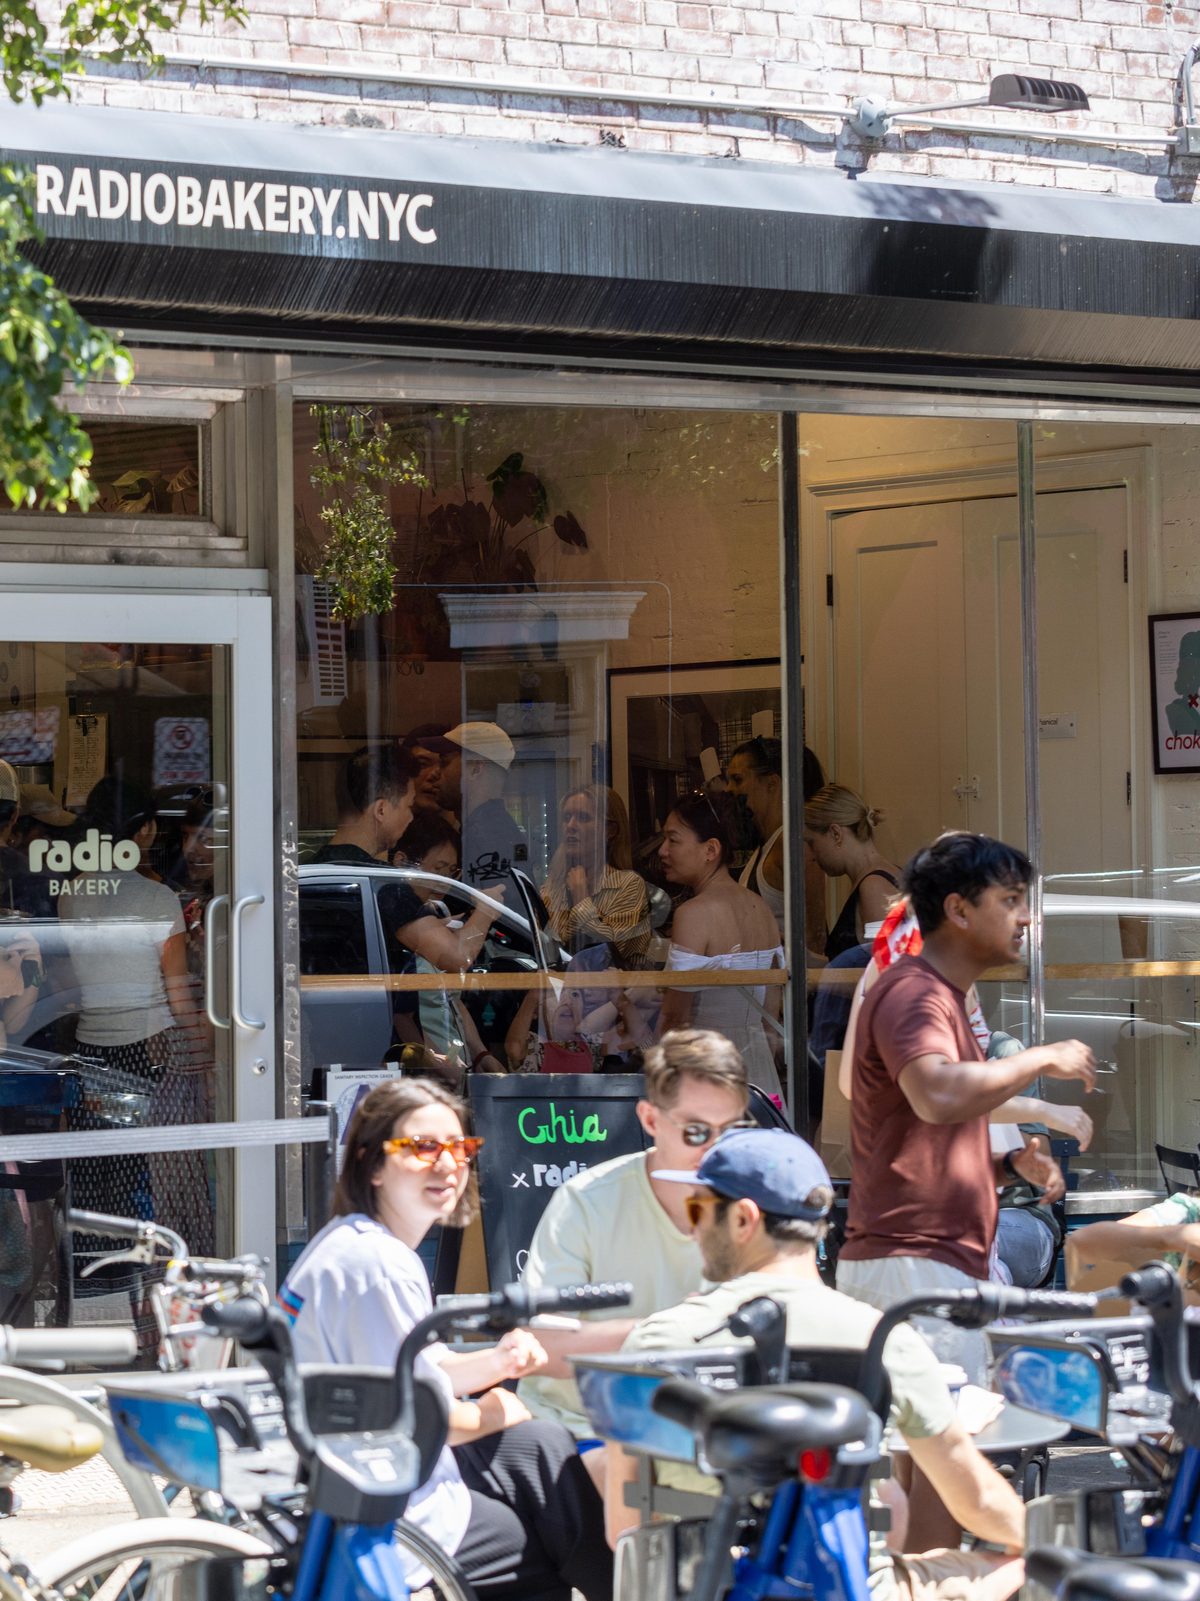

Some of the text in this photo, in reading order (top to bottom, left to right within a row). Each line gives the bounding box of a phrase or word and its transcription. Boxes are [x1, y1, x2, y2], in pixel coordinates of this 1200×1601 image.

[36, 164, 438, 245] RADIOBAKERY.NYC
[28, 827, 141, 873] radio
[49, 878, 123, 897] BAKERY
[517, 1101, 608, 1145] Ghia
